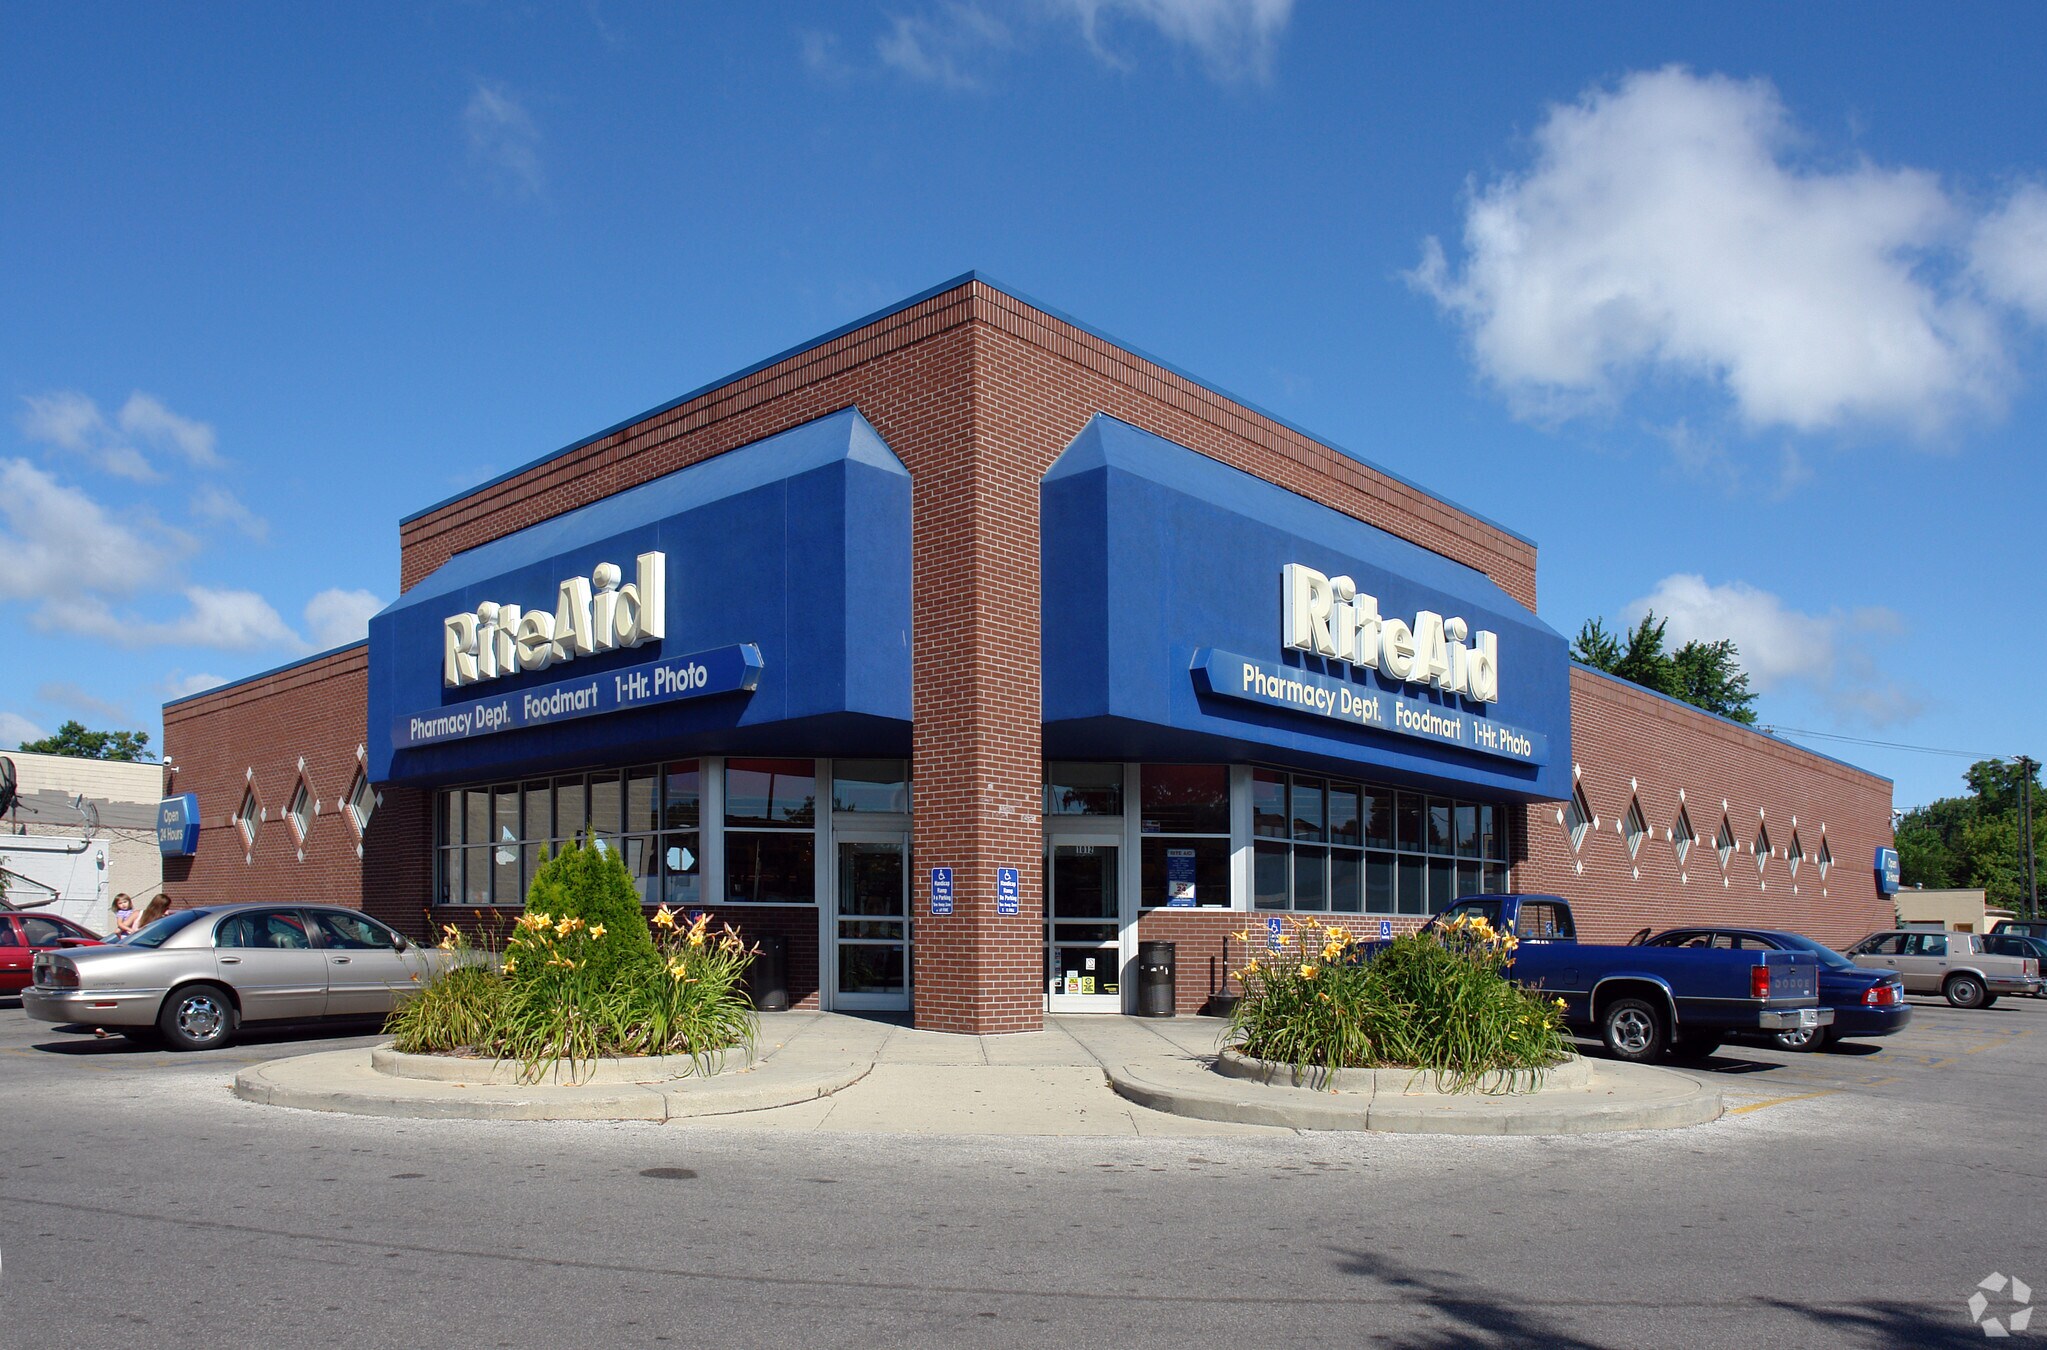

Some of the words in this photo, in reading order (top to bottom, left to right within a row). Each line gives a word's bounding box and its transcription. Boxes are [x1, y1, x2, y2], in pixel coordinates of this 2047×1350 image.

[410, 709, 472, 741] Pharmacy
[476, 700, 511, 731] Dept.
[524, 682, 598, 720] Foodmart
[615, 673, 650, 704] 1-Hr.
[654, 662, 708, 696] Photo
[1242, 663, 1336, 716] Pharmacy
[1340, 688, 1382, 724] Dept.
[1395, 702, 1462, 740] Foodmart
[1472, 721, 1498, 750] 1-Hr.
[1499, 730, 1532, 758] Photo
[164, 810, 179, 825] Open
[160, 829, 166, 842] 24
[168, 828, 183, 841] Hours
[1888, 858, 1896, 870] Open
[1775, 979, 1810, 988] DODGE
